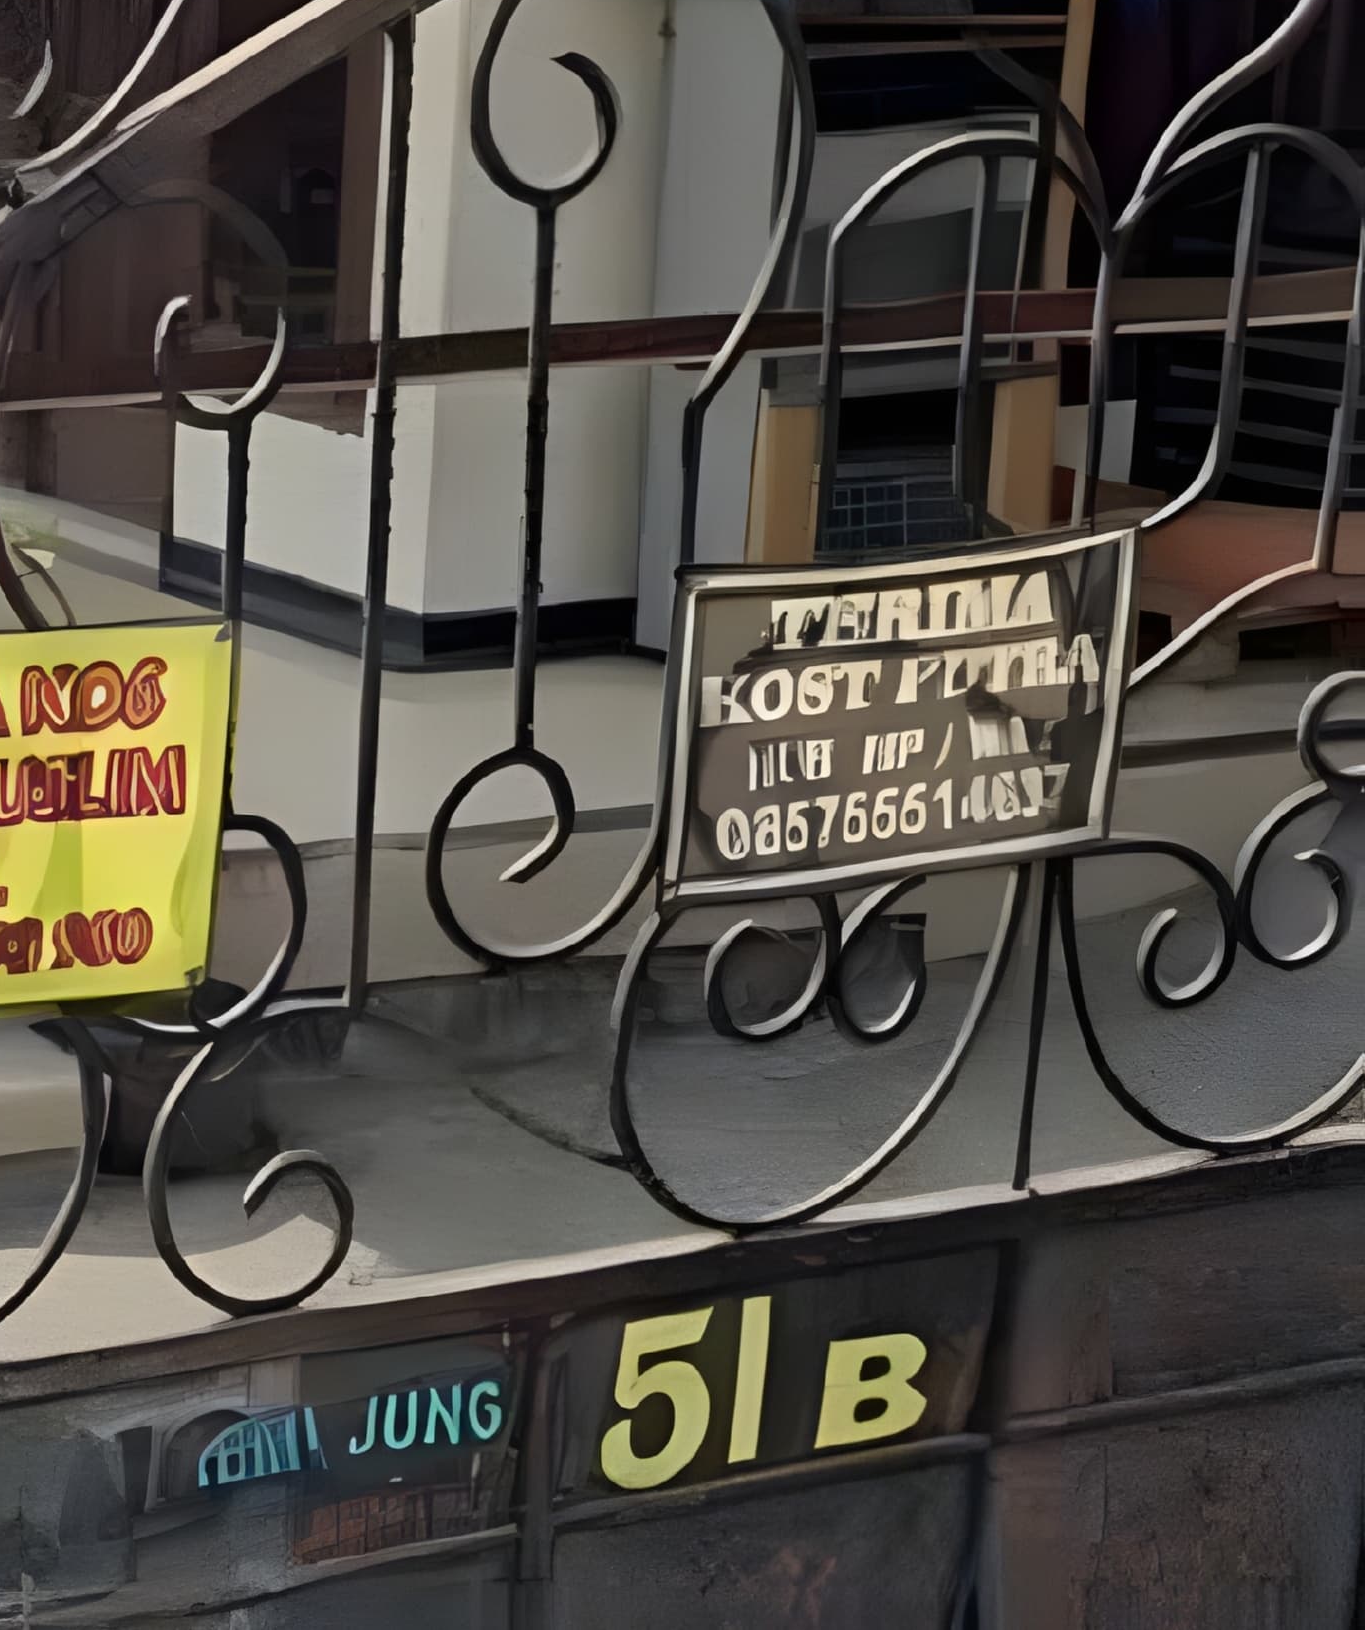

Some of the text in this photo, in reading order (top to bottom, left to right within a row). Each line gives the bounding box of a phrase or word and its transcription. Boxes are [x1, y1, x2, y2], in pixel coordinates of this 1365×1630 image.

[700, 659, 882, 727] KOST
[349, 1381, 503, 1456] JUNG
[600, 1296, 928, 1491] 51 B
